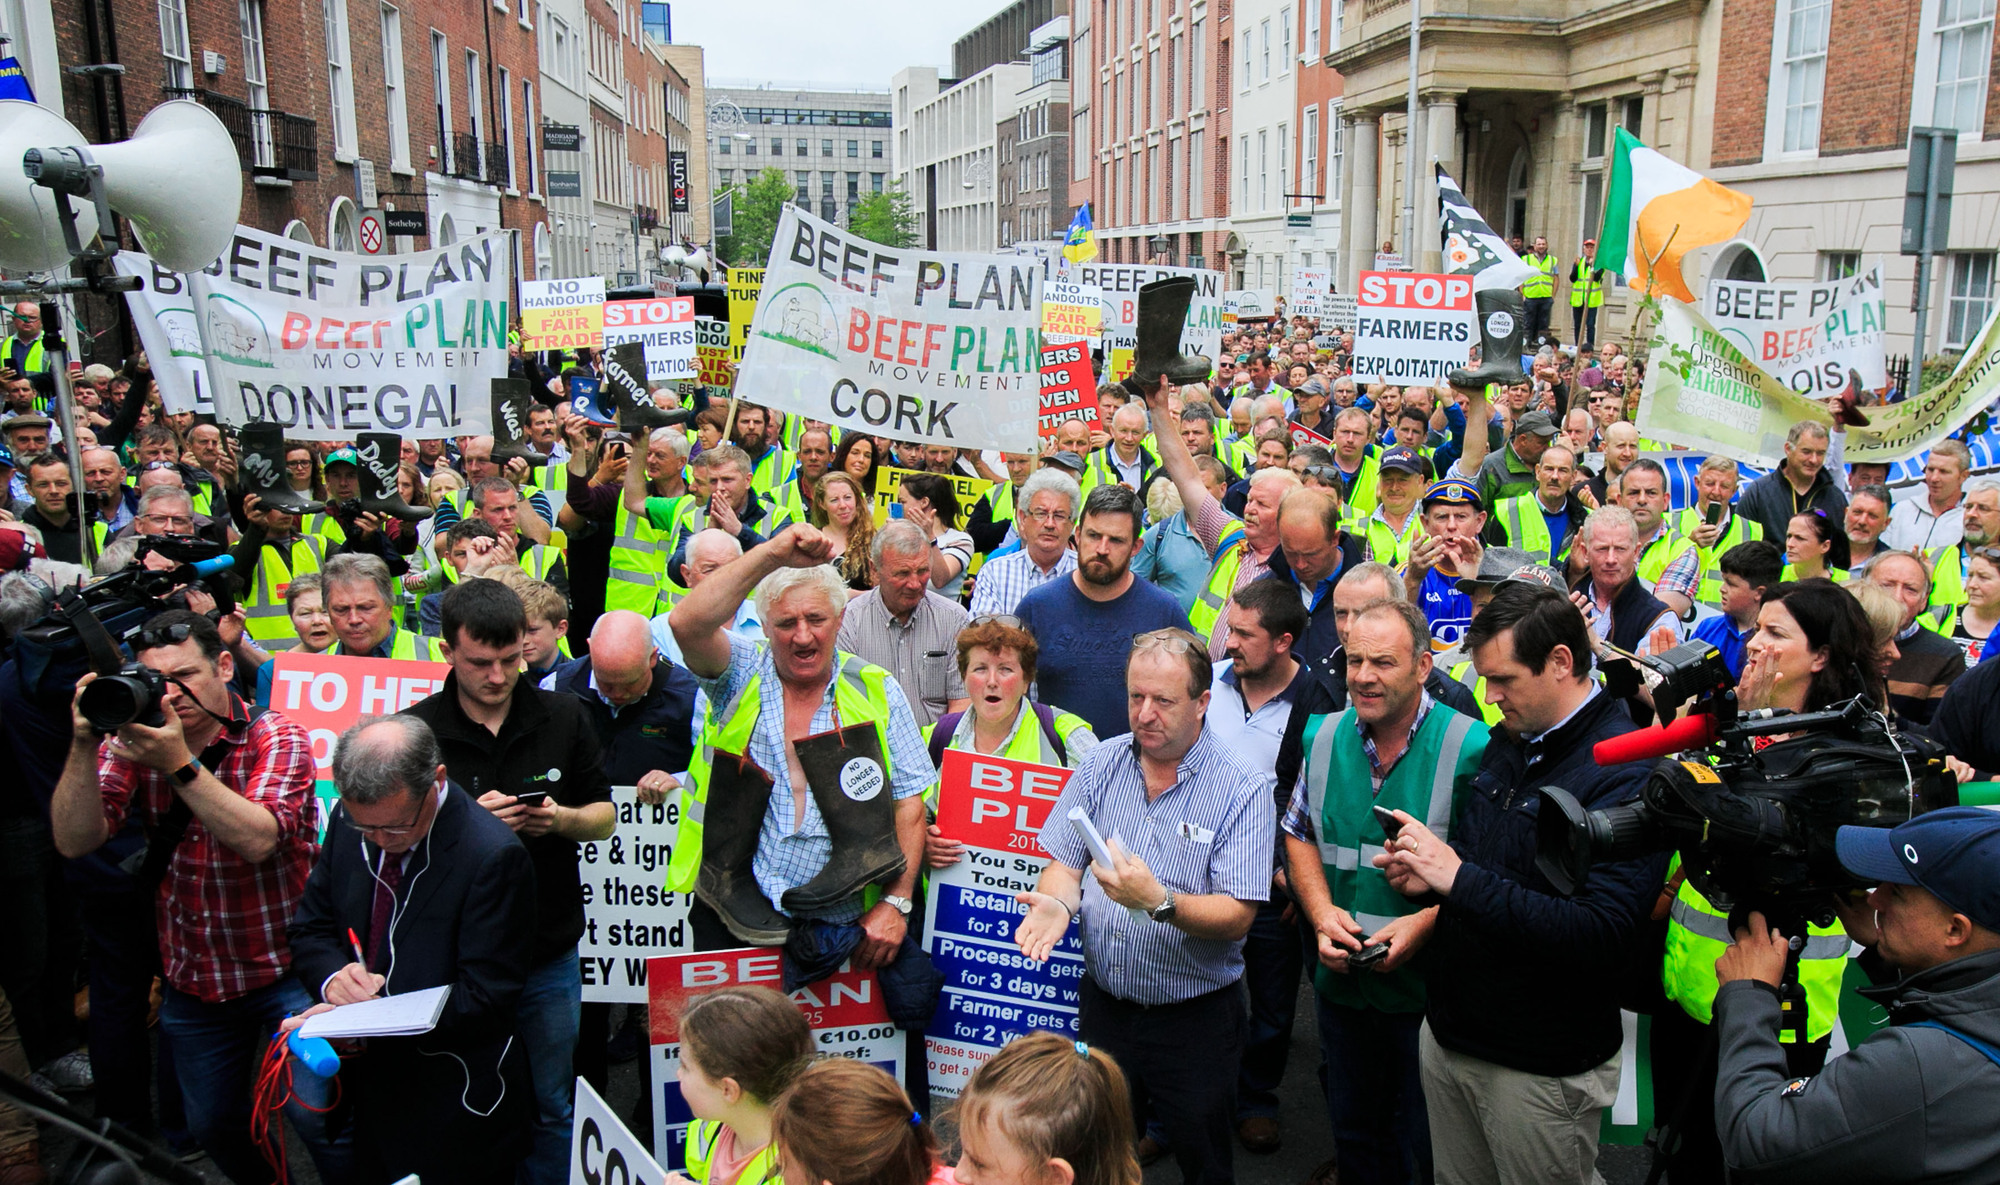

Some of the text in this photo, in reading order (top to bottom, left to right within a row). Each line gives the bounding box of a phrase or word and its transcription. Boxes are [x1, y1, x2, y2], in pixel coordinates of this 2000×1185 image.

[388, 220, 422, 229] Sotheby's
[360, 238, 492, 307] PLAN
[789, 218, 1034, 311] BEEF PLAN
[548, 281, 580, 295] NO
[1082, 267, 1145, 293] BEEF
[1305, 272, 1325, 281] WANT
[524, 294, 604, 307] HANDOUTS
[1044, 292, 1100, 306] ANDOUTS
[1055, 284, 1080, 294] NO
[1361, 275, 1470, 308] STOP
[550, 308, 581, 318] JUST
[605, 300, 691, 325] STOP
[1052, 304, 1083, 314] JUST
[1715, 286, 1798, 321] BEEF
[541, 317, 590, 332] FAIR
[695, 321, 726, 334] NO
[1042, 322, 1098, 337] TRADE
[1047, 311, 1087, 325] FAIR
[531, 331, 603, 349] TRADE
[1358, 318, 1469, 342] FARMERS
[313, 351, 480, 369] MOVEMENT
[697, 347, 727, 358] UST
[1778, 333, 1882, 369] MOVEMENT
[868, 360, 1022, 390] MOVEMENT
[1690, 342, 1761, 389] Organic
[1684, 367, 1762, 409] FARMERS
[239, 380, 462, 431] DONEGAL
[830, 378, 958, 438] CORK
[1677, 402, 1758, 435] SOCIETY LTD
[1383, 453, 1408, 463] glanbia
[244, 452, 280, 488] My
[357, 440, 399, 500] Daddy
[279, 670, 349, 712] TO
[846, 765, 875, 788] LONGER
[848, 761, 860, 773] NO
[853, 775, 881, 798] NEEDED
[608, 835, 625, 865] &
[967, 850, 1006, 870] You
[603, 876, 675, 907] these
[959, 889, 1031, 915] Retaile
[608, 918, 684, 948] stand
[967, 917, 1010, 937] for 3
[939, 939, 1086, 980] Processor gets
[961, 969, 986, 986] for
[990, 973, 1003, 989] 3
[1008, 976, 1057, 1000] days
[950, 994, 1023, 1022] Farmer
[1027, 1012, 1065, 1029] gets
[819, 1026, 895, 1044] €10.00
[954, 1021, 980, 1038] for
[983, 1024, 997, 1042] 2
[926, 1039, 965, 1057] Please
[940, 1061, 958, 1076] get
[962, 1067, 969, 1076] a
